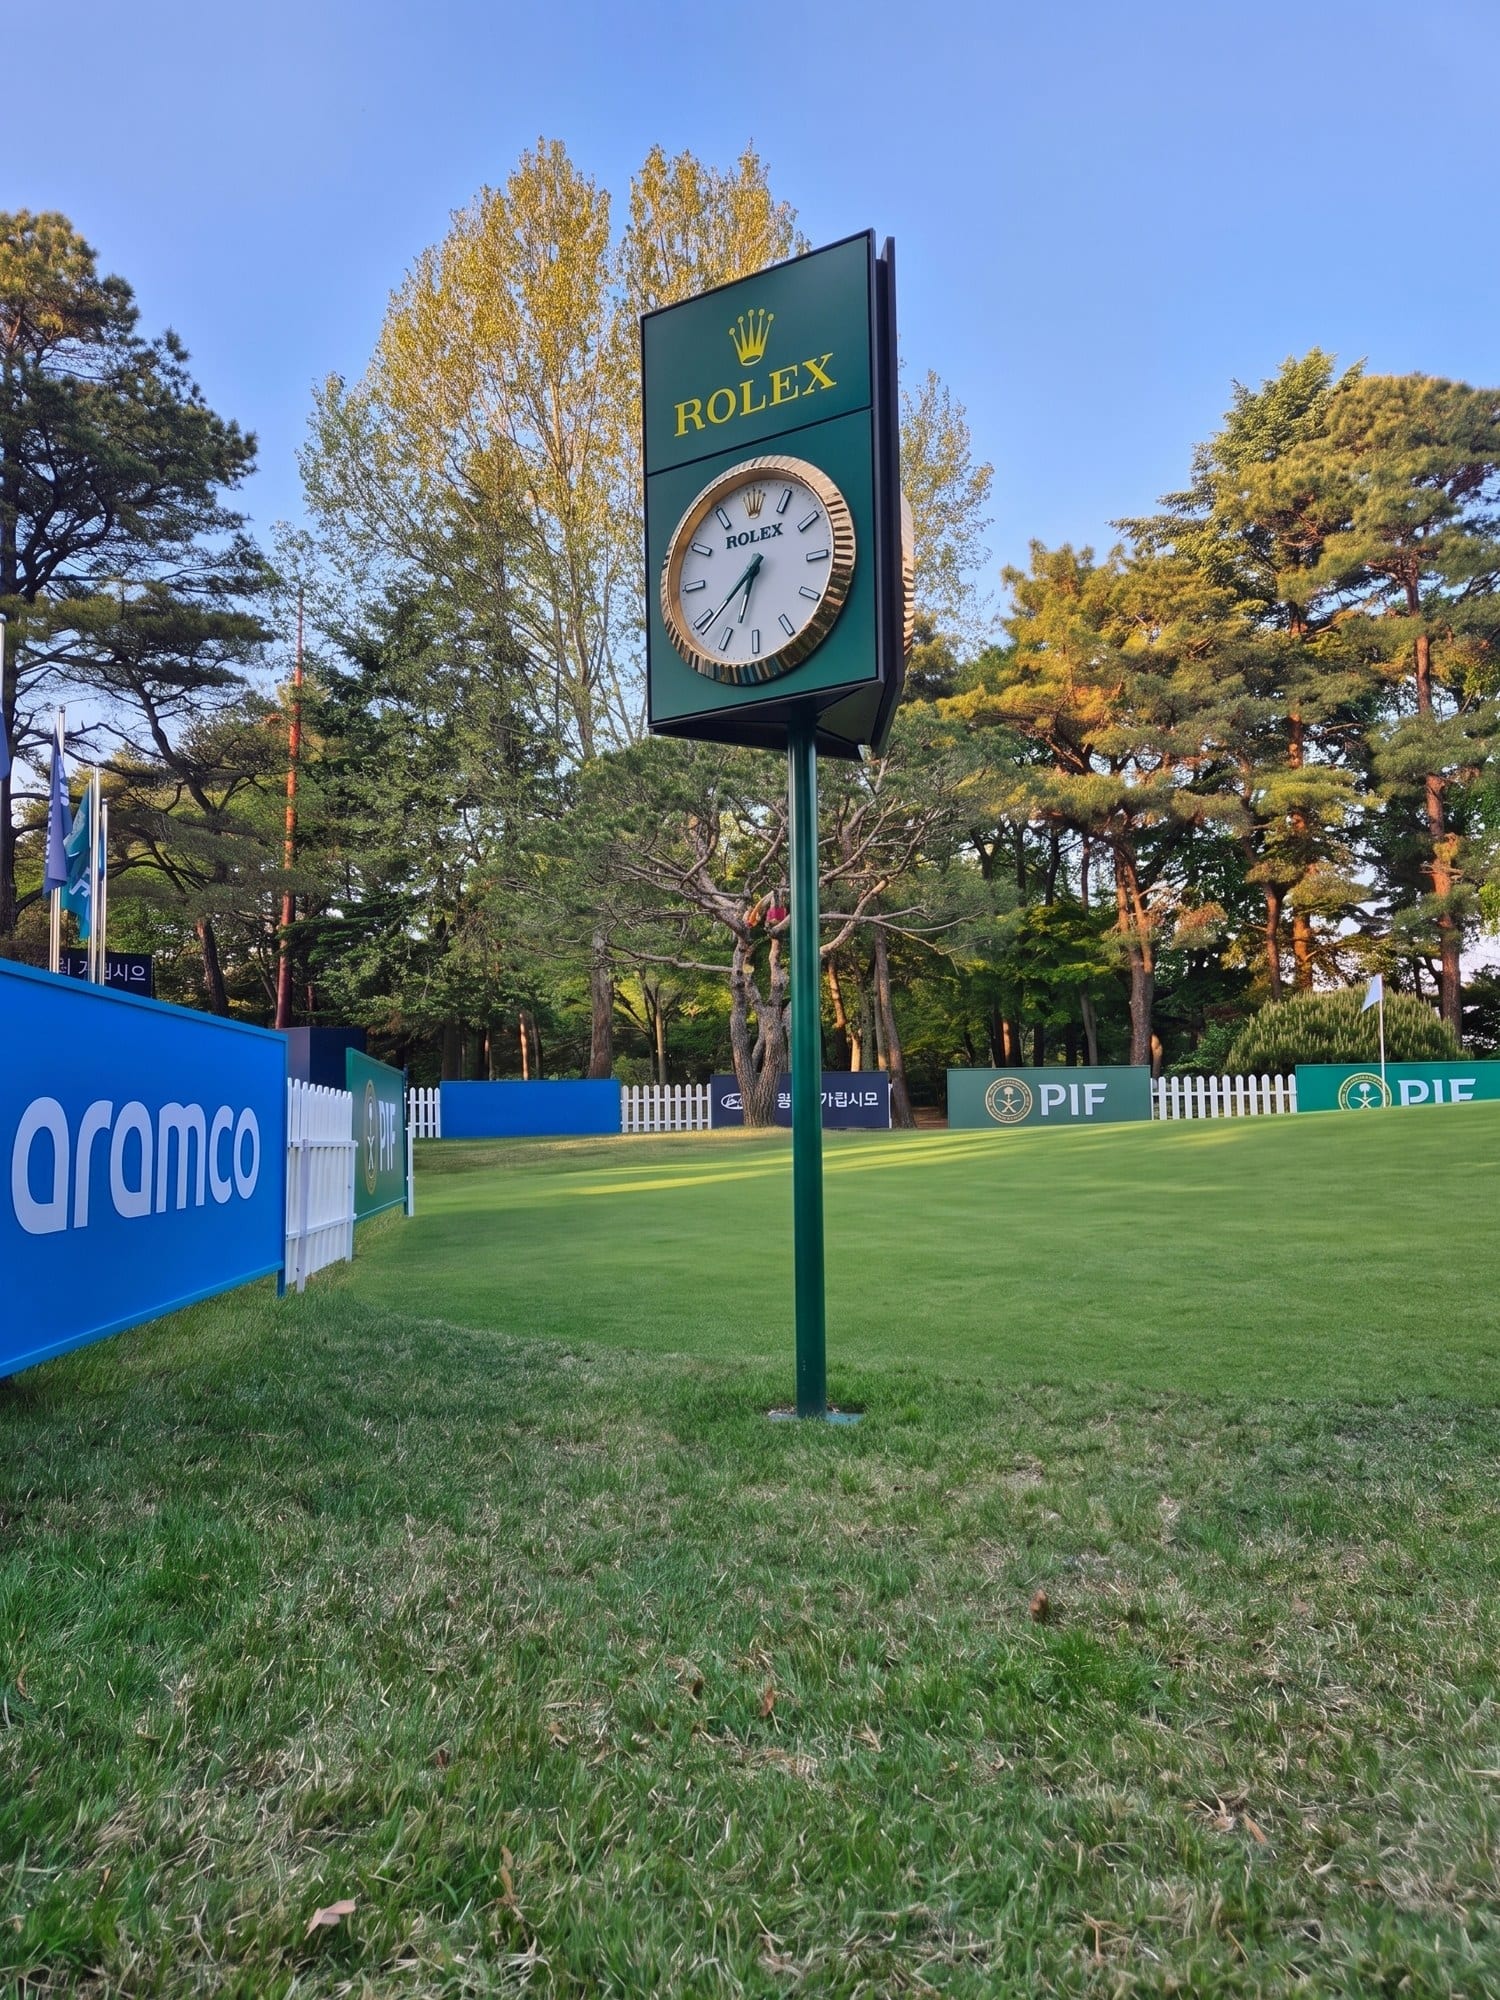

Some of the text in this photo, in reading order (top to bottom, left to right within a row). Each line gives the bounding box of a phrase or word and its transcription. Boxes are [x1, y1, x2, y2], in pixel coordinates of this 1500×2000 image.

[673, 352, 838, 438] ROLEX
[725, 522, 784, 550] ROLEX
[1037, 1083, 1108, 1116] PIF
[1397, 1078, 1477, 1106] PIF
[378, 1100, 396, 1172] PIF
[11, 1096, 261, 1235] aramco
